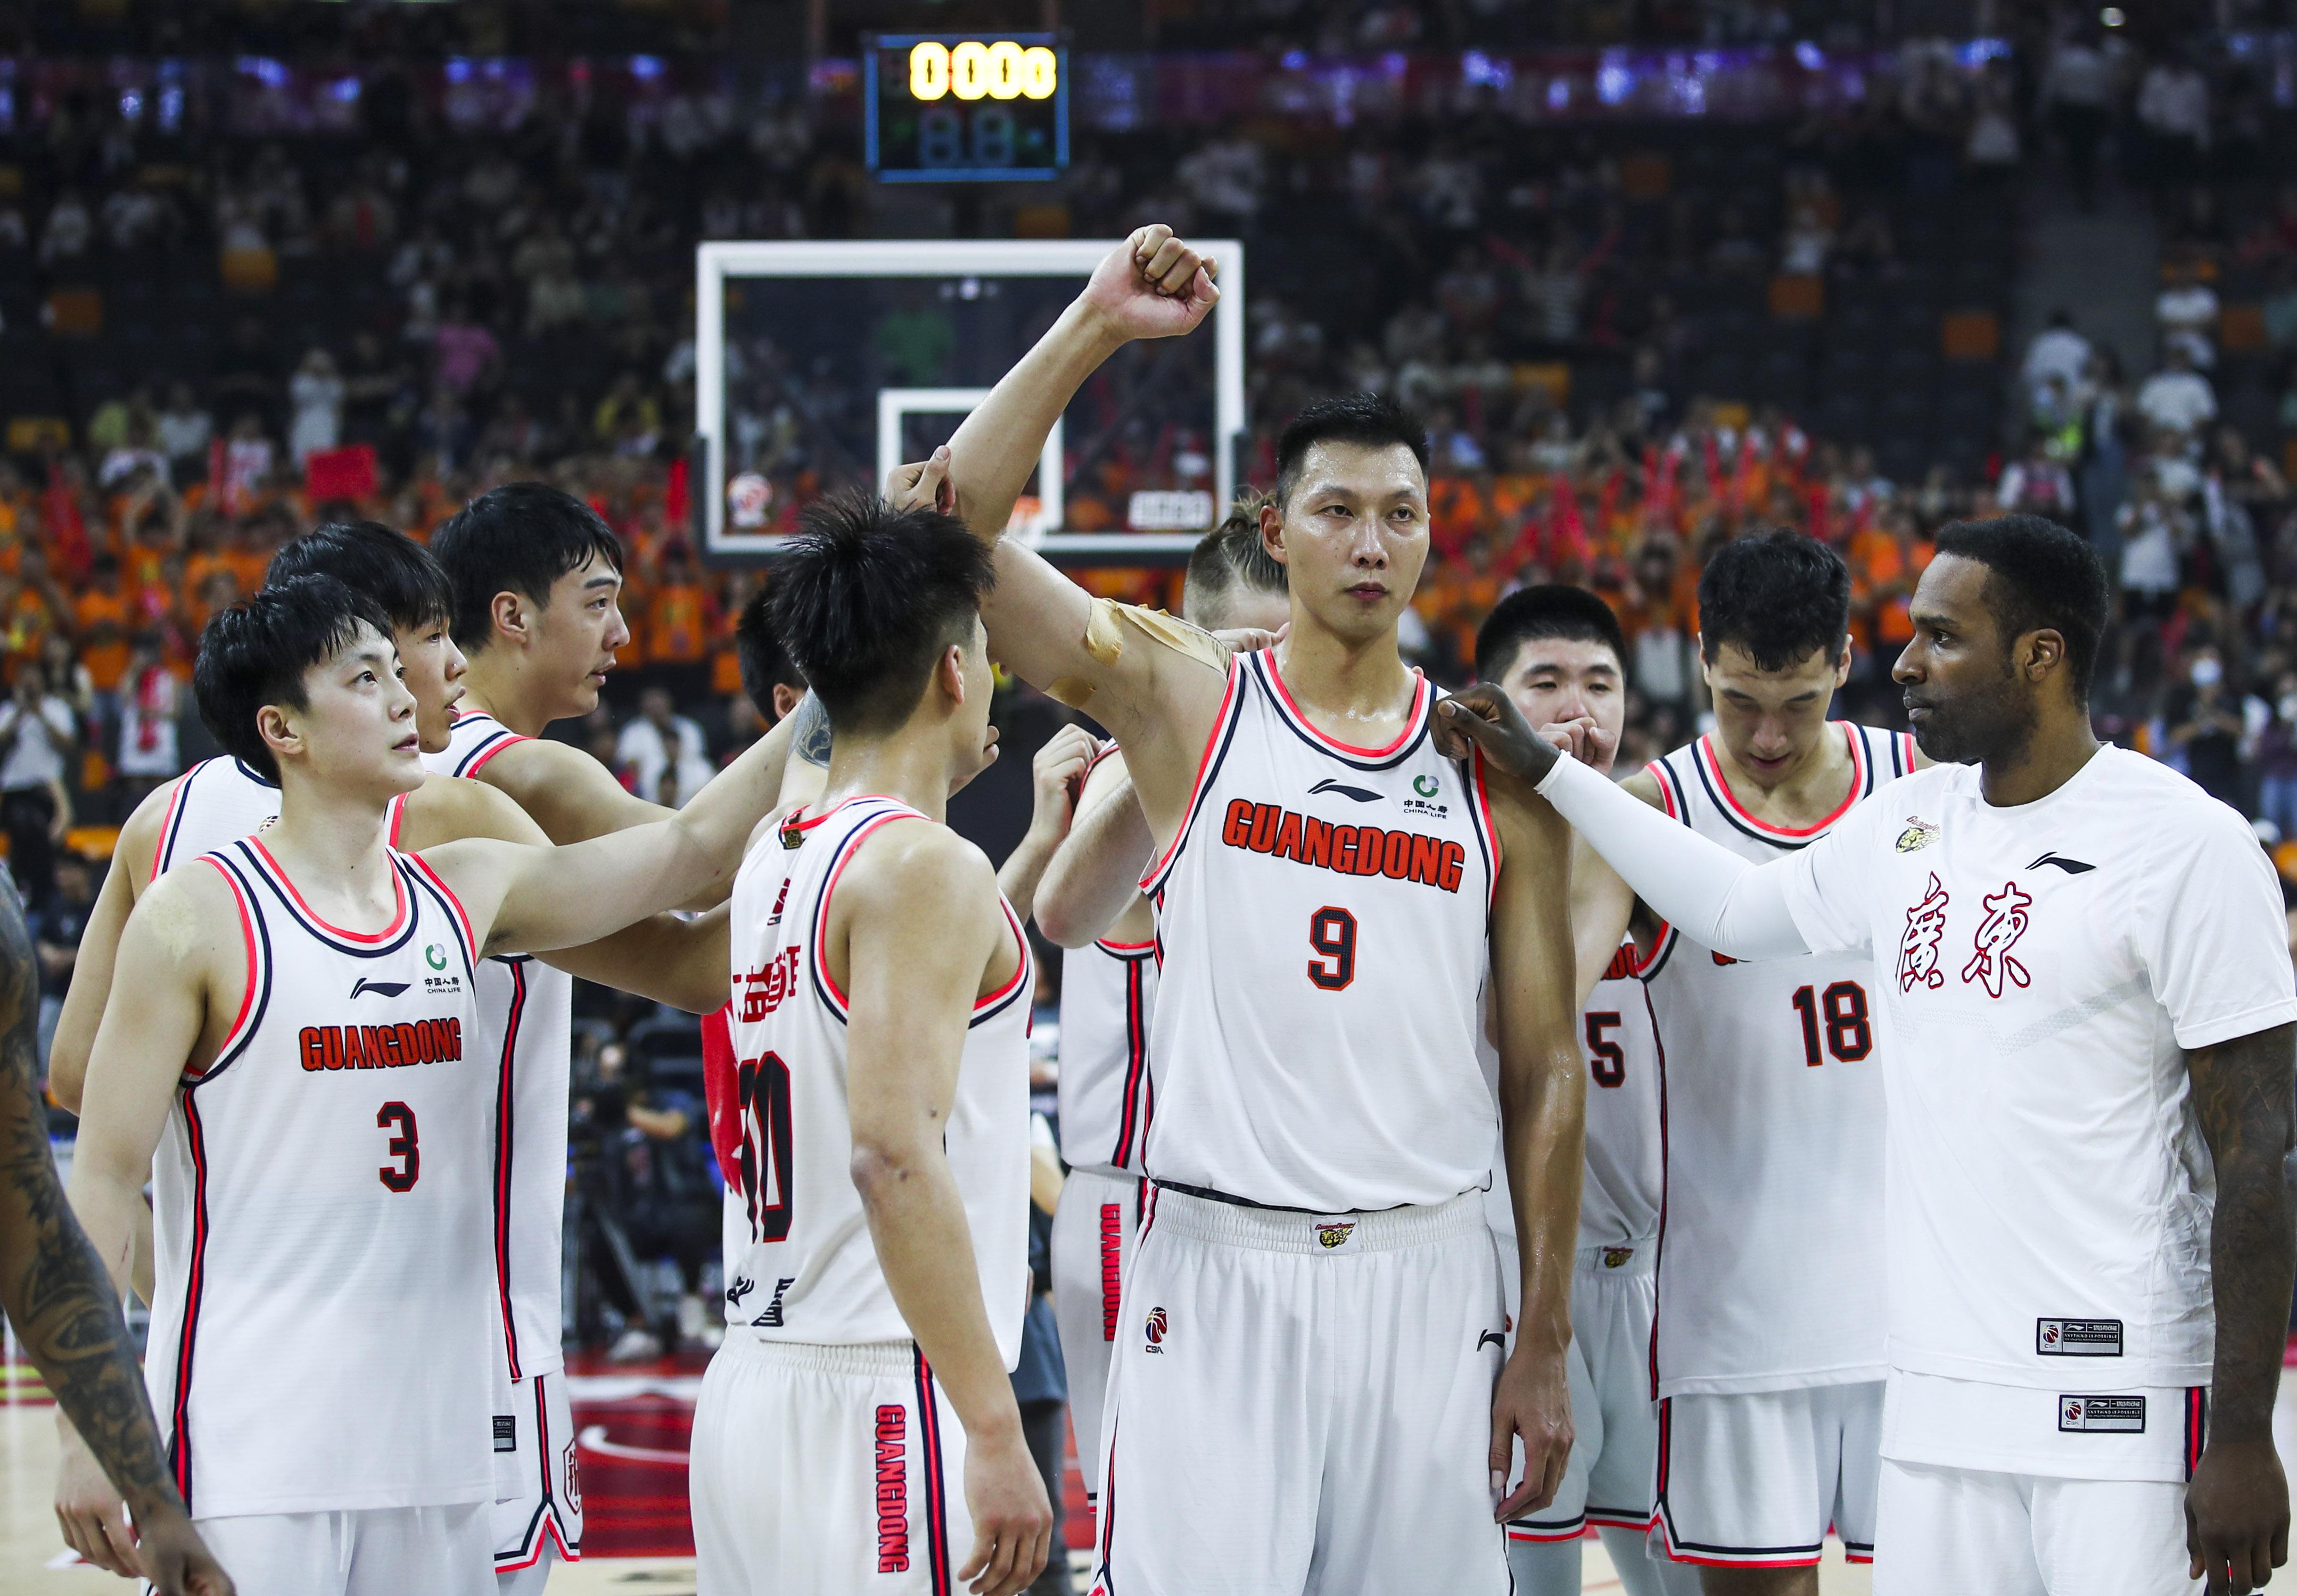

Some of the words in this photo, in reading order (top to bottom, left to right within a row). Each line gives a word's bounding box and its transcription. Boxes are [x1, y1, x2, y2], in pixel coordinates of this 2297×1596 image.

[1222, 798, 1465, 894] GUANGDONG
[1404, 799, 1447, 814] 中国人寿
[425, 977, 459, 987] 中国人寿
[1307, 905, 1357, 991] 9
[299, 1017, 462, 1072] GUANGDONG
[1585, 1011, 1626, 1088] 5
[1792, 980, 1873, 1067] 18
[376, 1101, 420, 1193] 3
[1146, 1345, 1164, 1354] CBA
[875, 1404, 910, 1574] GUANGDONG
